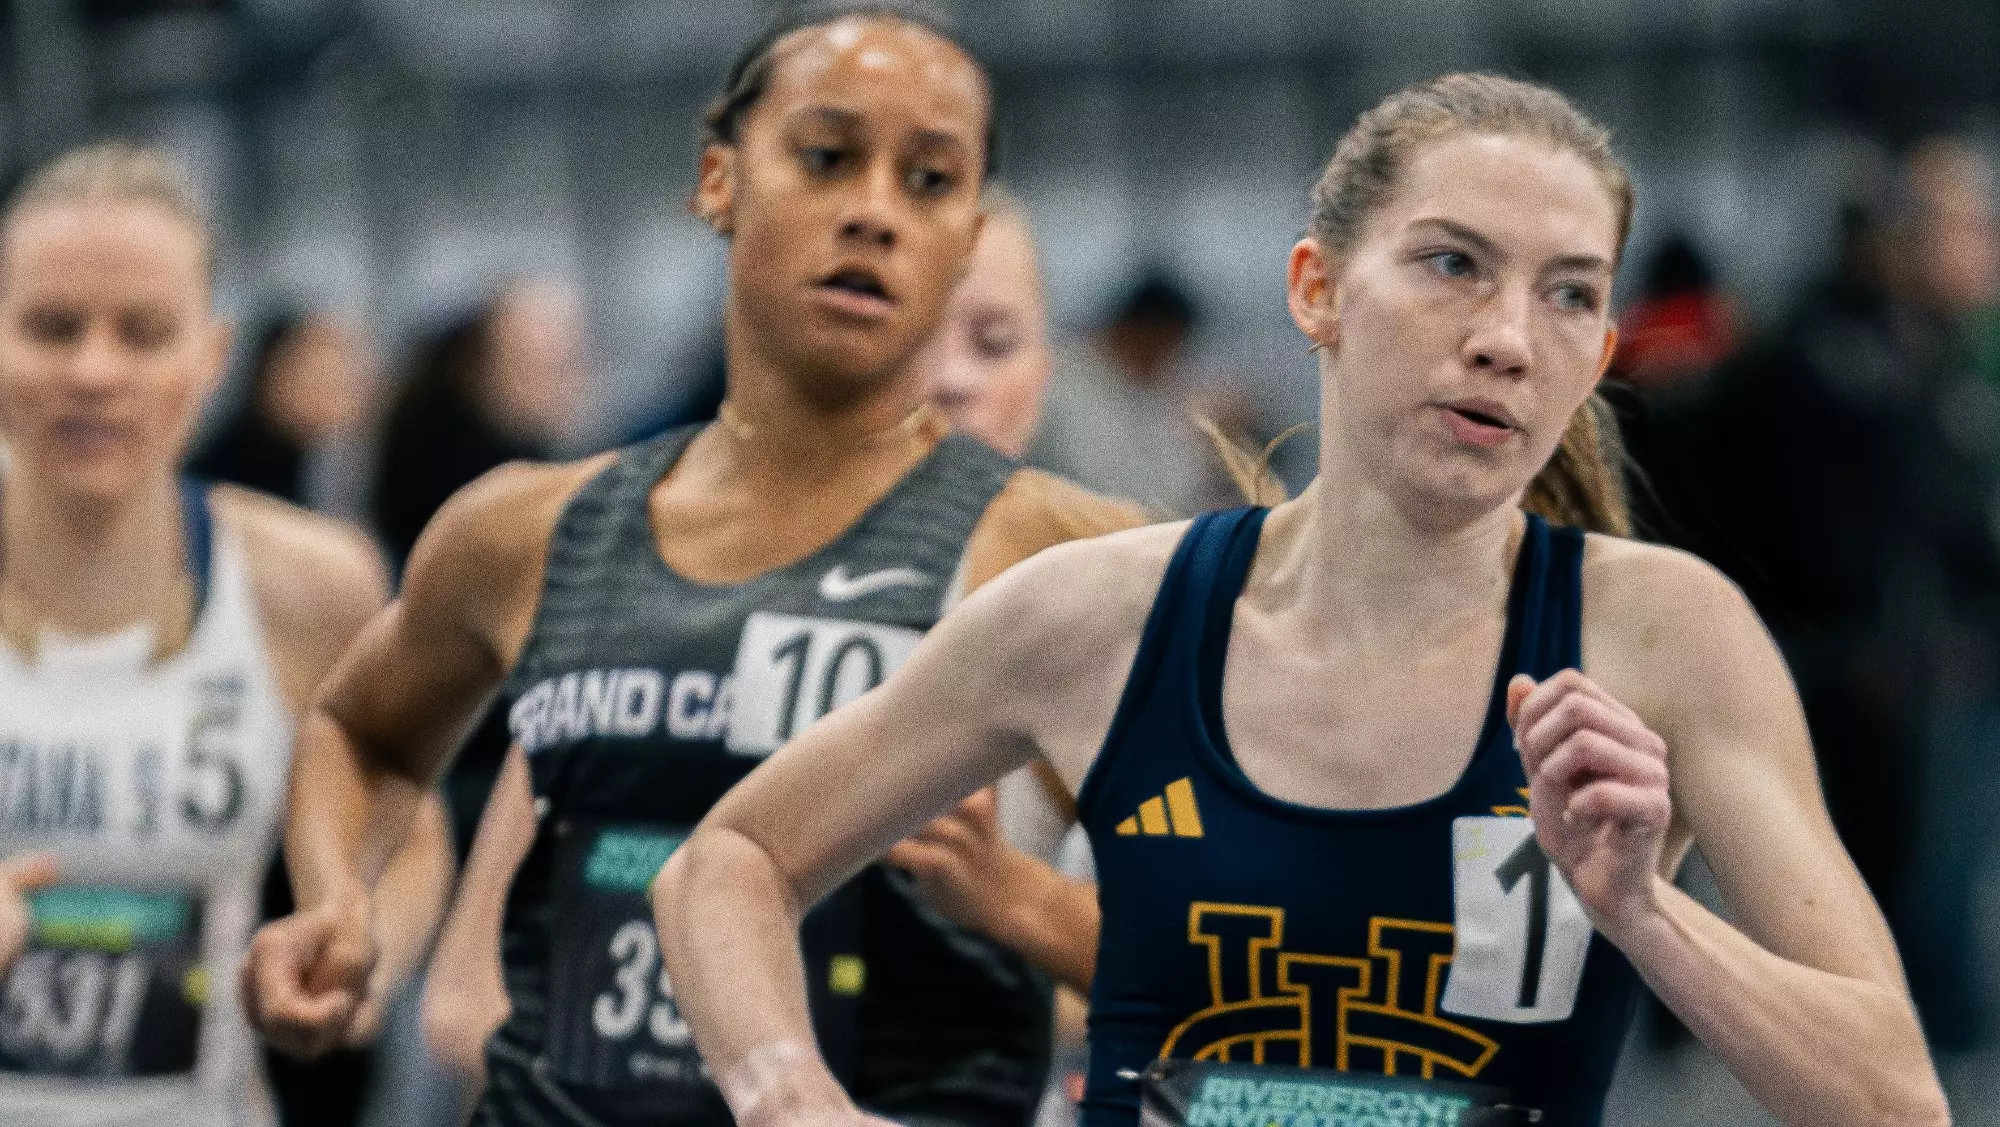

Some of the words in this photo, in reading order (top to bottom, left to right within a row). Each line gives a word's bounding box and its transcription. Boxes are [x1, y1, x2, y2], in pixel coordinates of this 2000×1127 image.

[772, 629, 885, 744] 10
[180, 703, 246, 836] 5
[1494, 830, 1553, 1008] 1
[1201, 1076, 1472, 1122] RIVERFRONT
